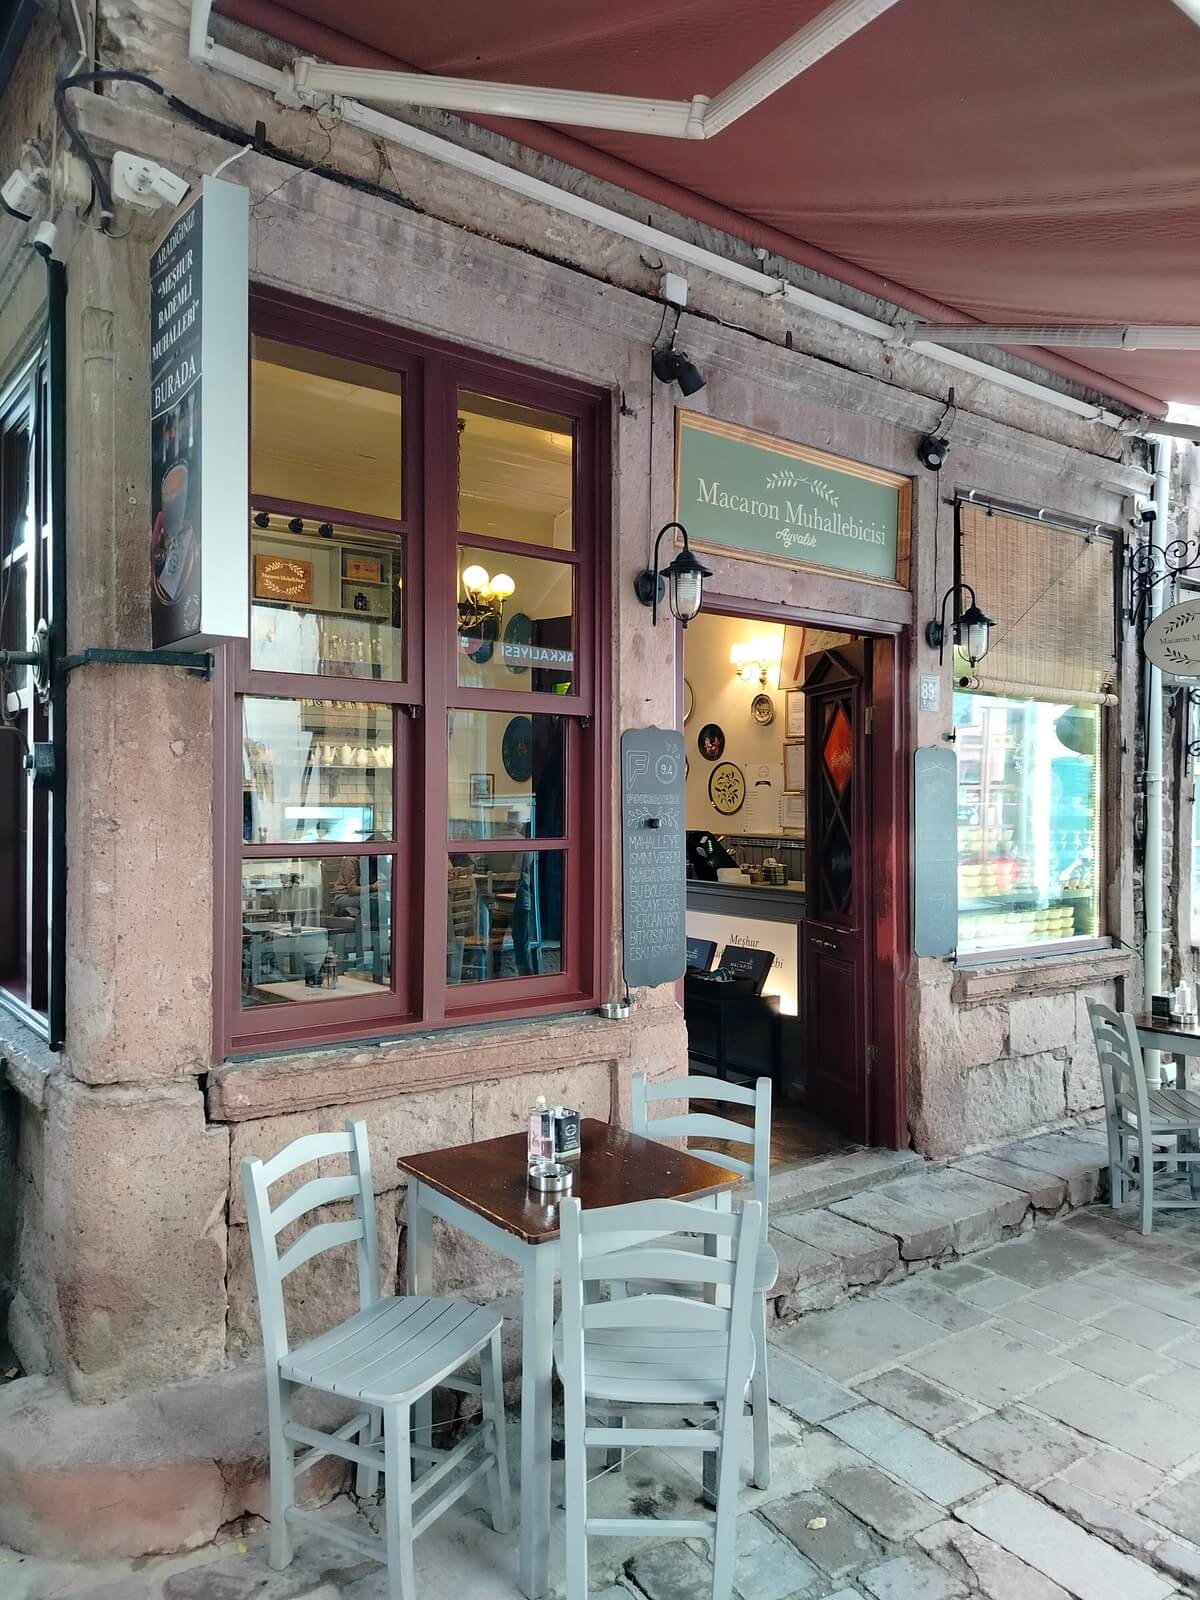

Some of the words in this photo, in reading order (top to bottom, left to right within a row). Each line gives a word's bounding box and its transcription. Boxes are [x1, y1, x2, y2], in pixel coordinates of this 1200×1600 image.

[156, 208, 196, 268] ARADIĞINIZ
[157, 279, 193, 330] BADEMLİ
[154, 354, 197, 410] BURADA
[696, 477, 780, 521] Macaron
[784, 501, 887, 546] Muhallebicisi
[922, 682, 935, 700] 89
